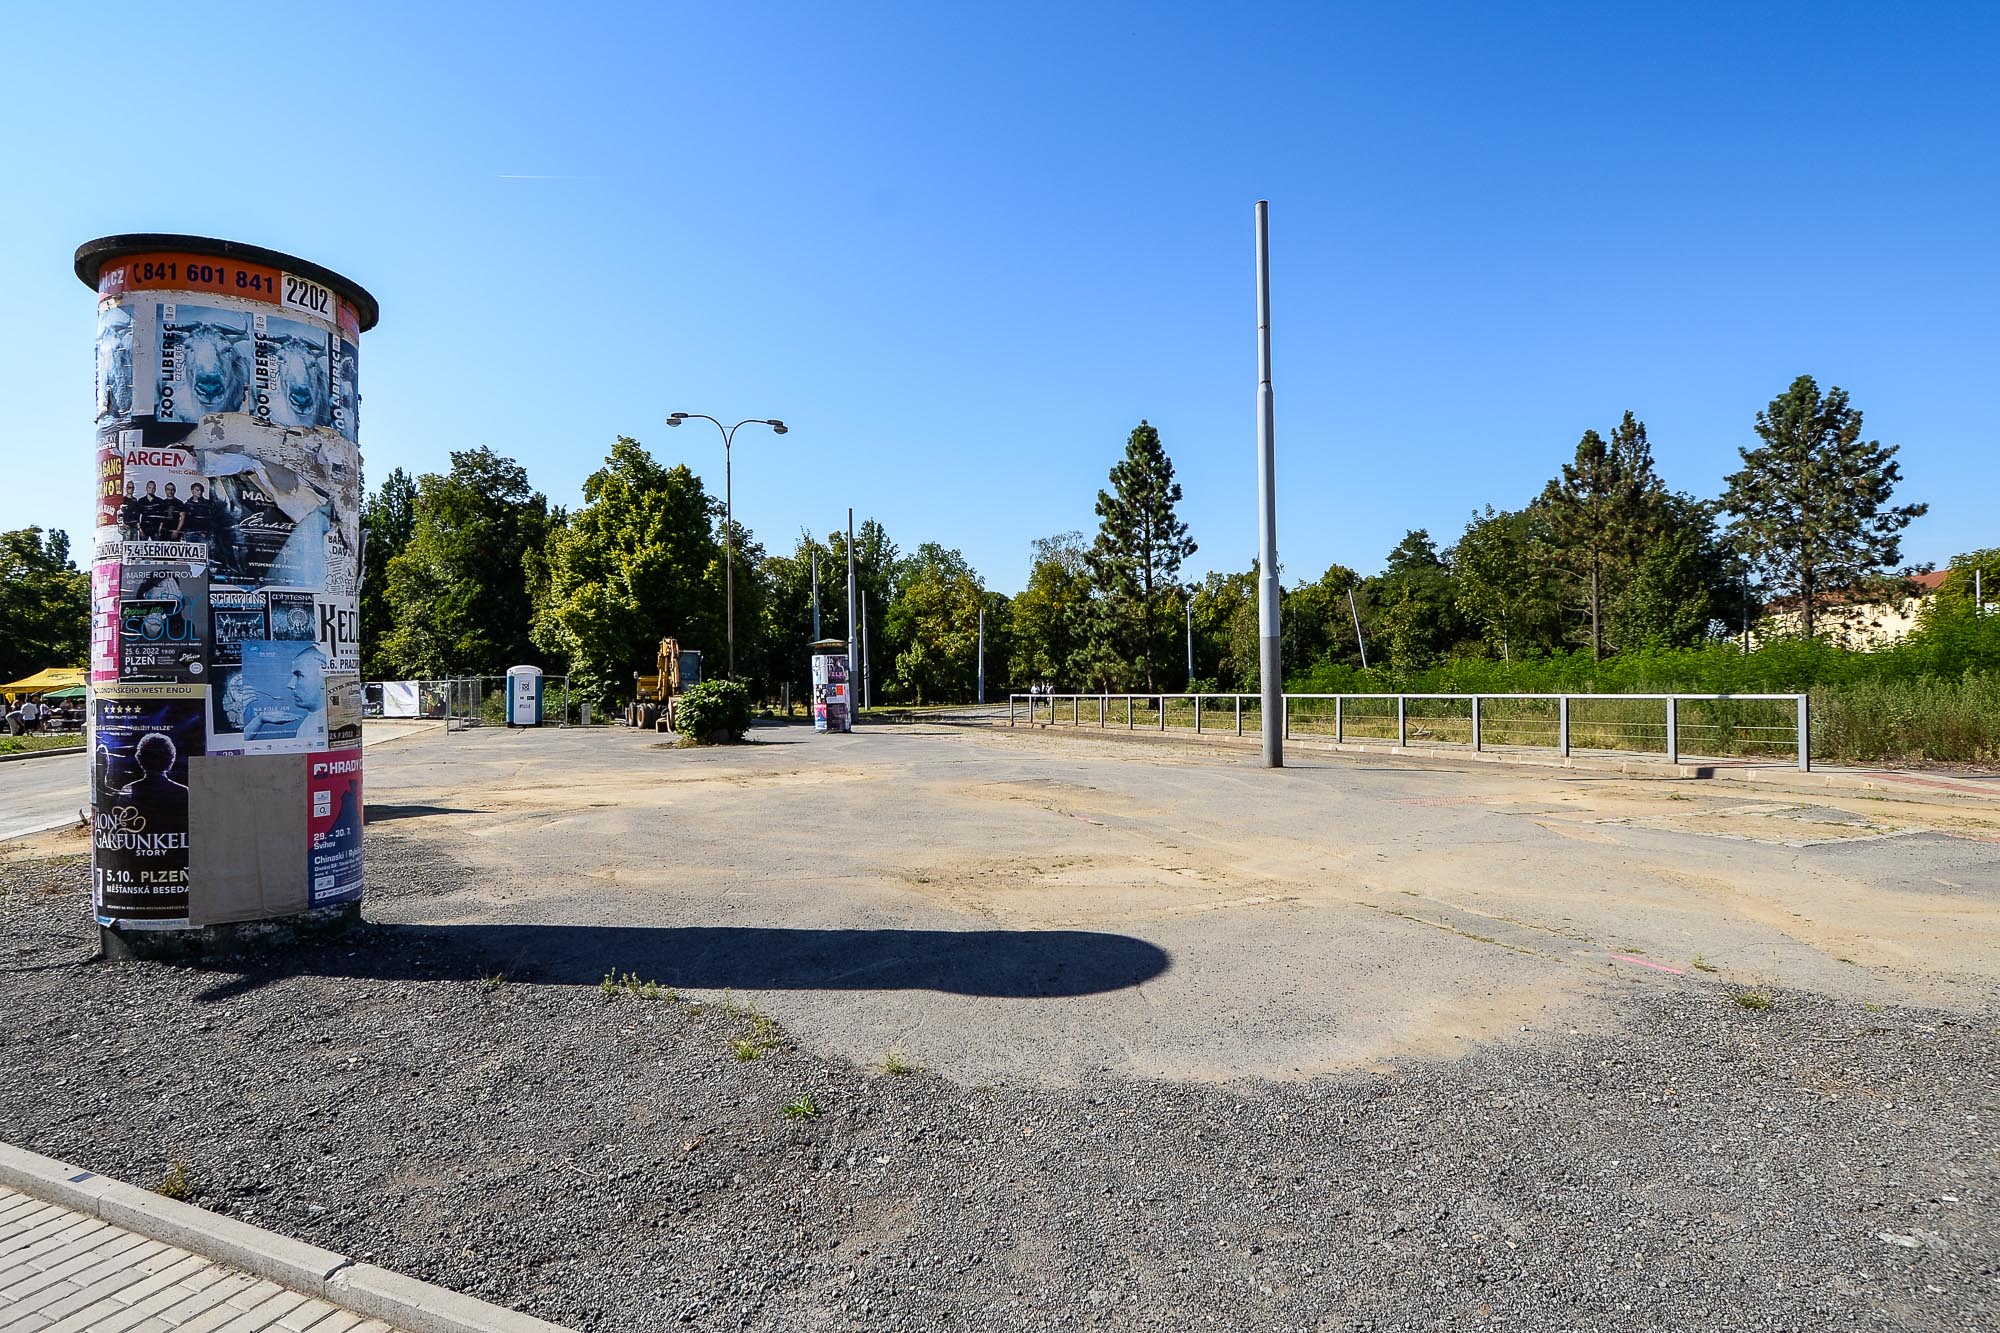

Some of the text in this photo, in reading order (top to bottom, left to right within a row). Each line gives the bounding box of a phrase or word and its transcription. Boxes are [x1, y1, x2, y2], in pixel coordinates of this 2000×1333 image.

[144, 262, 273, 294] 841 601 841
[286, 277, 329, 315] 2202
[162, 323, 176, 381] LIBEREC
[254, 332, 269, 389] LIBEREC
[161, 386, 174, 418] ZOO
[153, 571, 201, 579] ROTTROV
[209, 593, 266, 604] SCORPIONS
[125, 617, 201, 641] SOUL
[142, 647, 160, 655] 2022
[125, 655, 156, 666] PLZEŇ
[136, 849, 167, 857] STORY
[106, 866, 189, 883] 5.10. PLZEŇ
[153, 885, 189, 894] BESEDA
